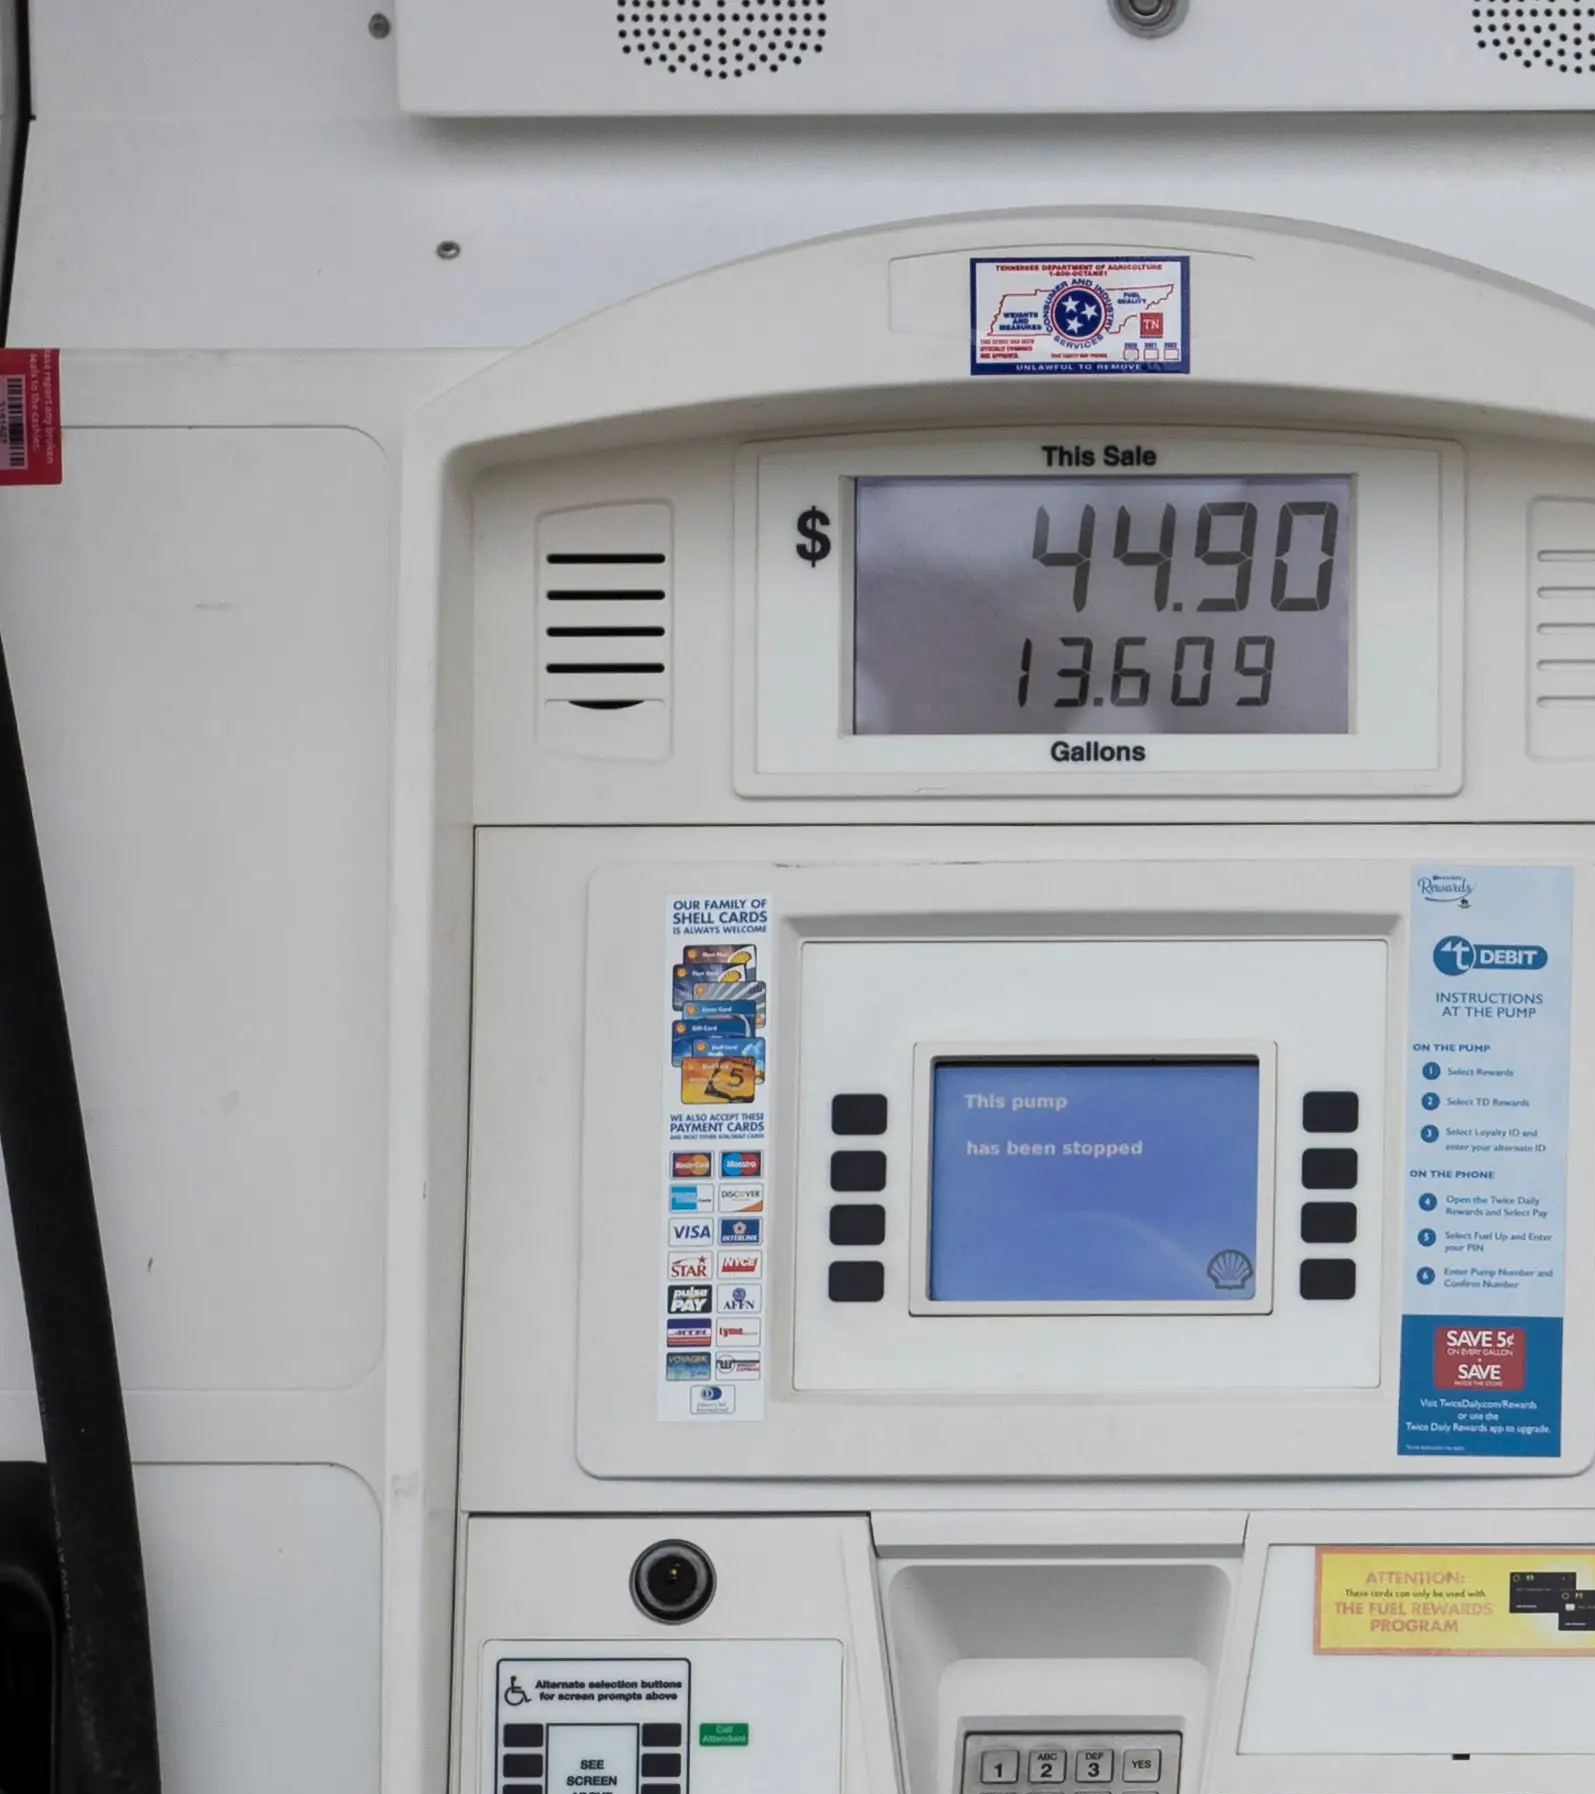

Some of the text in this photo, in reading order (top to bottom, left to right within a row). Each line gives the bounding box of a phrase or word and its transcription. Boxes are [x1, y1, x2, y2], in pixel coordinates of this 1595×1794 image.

[1144, 319, 1160, 329] TN
[1042, 446, 1157, 467] This Sale
[795, 501, 1339, 613] $ 44.90
[1017, 635, 1275, 708] 13.609
[1050, 741, 1146, 764] Gallons
[673, 899, 767, 911] OUR FAMILY OF
[673, 911, 768, 924] SHELL CARDS
[683, 926, 720, 934] ALWAYS
[1480, 950, 1538, 965] DEBIT
[1436, 992, 1544, 1004] INSTRUCTIONS
[1442, 1007, 1537, 1018] AT THE PUMP
[965, 1094, 1068, 1111] This pump
[670, 1122, 765, 1133] PAYMENT CARDS
[967, 1140, 1143, 1158] has been stopped
[721, 1190, 760, 1198] DISCOVER
[674, 1226, 711, 1238] VISA
[672, 1264, 707, 1277] STAR
[1446, 1331, 1493, 1347] SAVE
[1458, 1365, 1501, 1380] SAVE
[535, 1680, 682, 1689] Alternate selection buttons
[540, 1692, 677, 1702] for screen prompts above
[580, 1760, 604, 1770] SEE
[1132, 1760, 1151, 1769] YES
[567, 1776, 617, 1786] SCREEN
